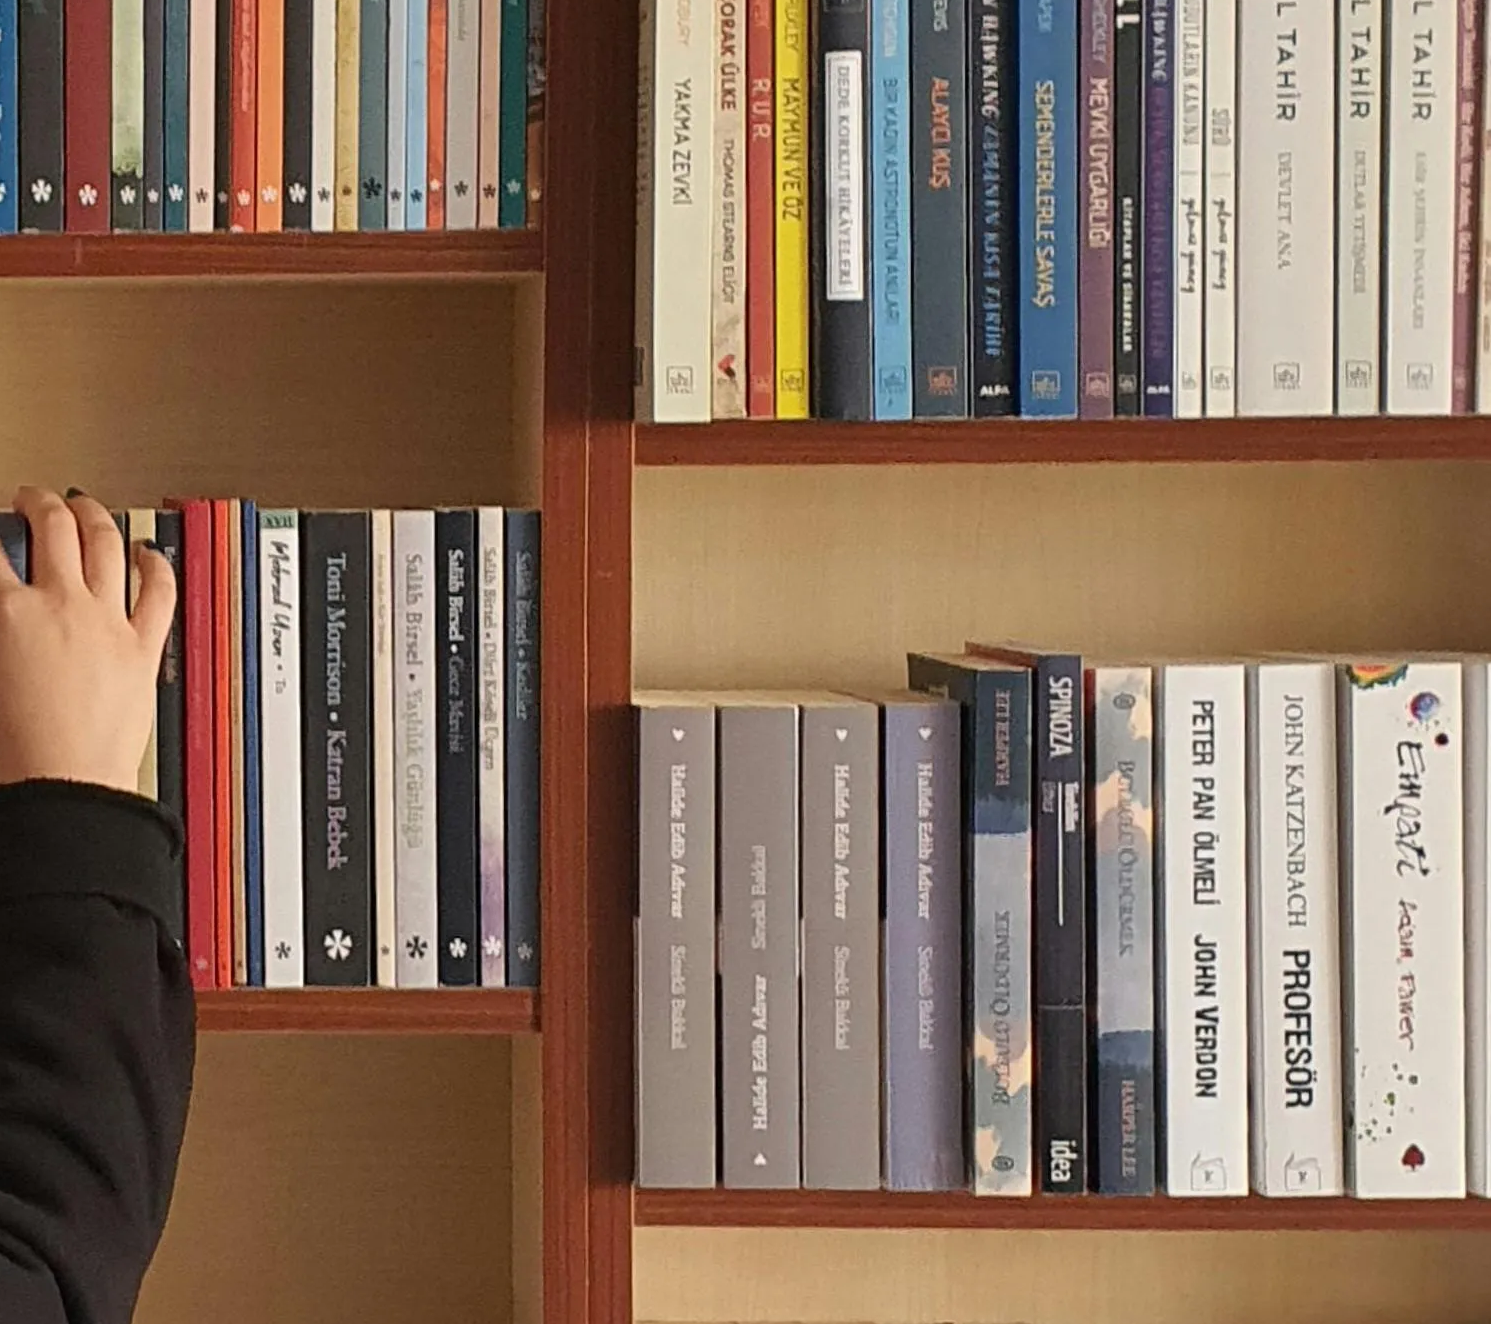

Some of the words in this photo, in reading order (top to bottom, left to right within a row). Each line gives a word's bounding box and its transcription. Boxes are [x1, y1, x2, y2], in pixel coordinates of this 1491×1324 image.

[720, 62, 742, 111] ÜLKE
[751, 78, 770, 98] R.
[837, 65, 852, 106] DEDE
[981, 14, 1001, 119] HAWKING
[1275, 29, 1302, 122] TAHİR
[1349, 28, 1375, 119] TAHİR
[1411, 29, 1439, 121] TAHİR
[671, 78, 690, 144] YAKMA
[751, 101, 770, 121] U.
[751, 123, 770, 142] R.
[782, 78, 801, 163] MAYMUN
[931, 77, 951, 143] ALAYCI
[672, 149, 695, 205] ZEVKİ
[721, 139, 735, 197] THOMAS
[835, 109, 852, 183] KORKUT
[928, 148, 951, 189] KUŞ
[1035, 79, 1055, 242] SEMENDERLERLE
[782, 167, 801, 192] VE
[782, 196, 806, 220] ÖZ
[1088, 144, 1111, 248] UYGARLIĞI
[721, 201, 736, 263] STEARNS
[984, 232, 1001, 280] KISA
[1276, 230, 1293, 270] ANA
[1031, 245, 1056, 308] SAVAŞ
[978, 384, 1010, 397] ALFA
[326, 553, 347, 602] Toni
[326, 607, 347, 706] Morrison
[405, 612, 424, 666] Birsel
[993, 689, 1011, 719] LEE
[1048, 676, 1074, 758] SPINOZA
[1192, 700, 1215, 766] PETER
[1282, 694, 1306, 757] JOHN
[326, 729, 348, 800] Katran
[669, 765, 687, 818] Halide
[833, 764, 851, 819] Halide
[1192, 778, 1215, 820] PAN
[1384, 741, 1431, 879] Empati
[326, 806, 348, 871] Bebek
[1193, 831, 1221, 905] ÖLMELİ
[1283, 764, 1306, 927] KATZENBACH
[1193, 934, 1218, 998] JOHN
[1193, 1006, 1220, 1099] VERDON
[1281, 950, 1318, 1108] PROFESÖR
[1049, 1139, 1078, 1183] idea
